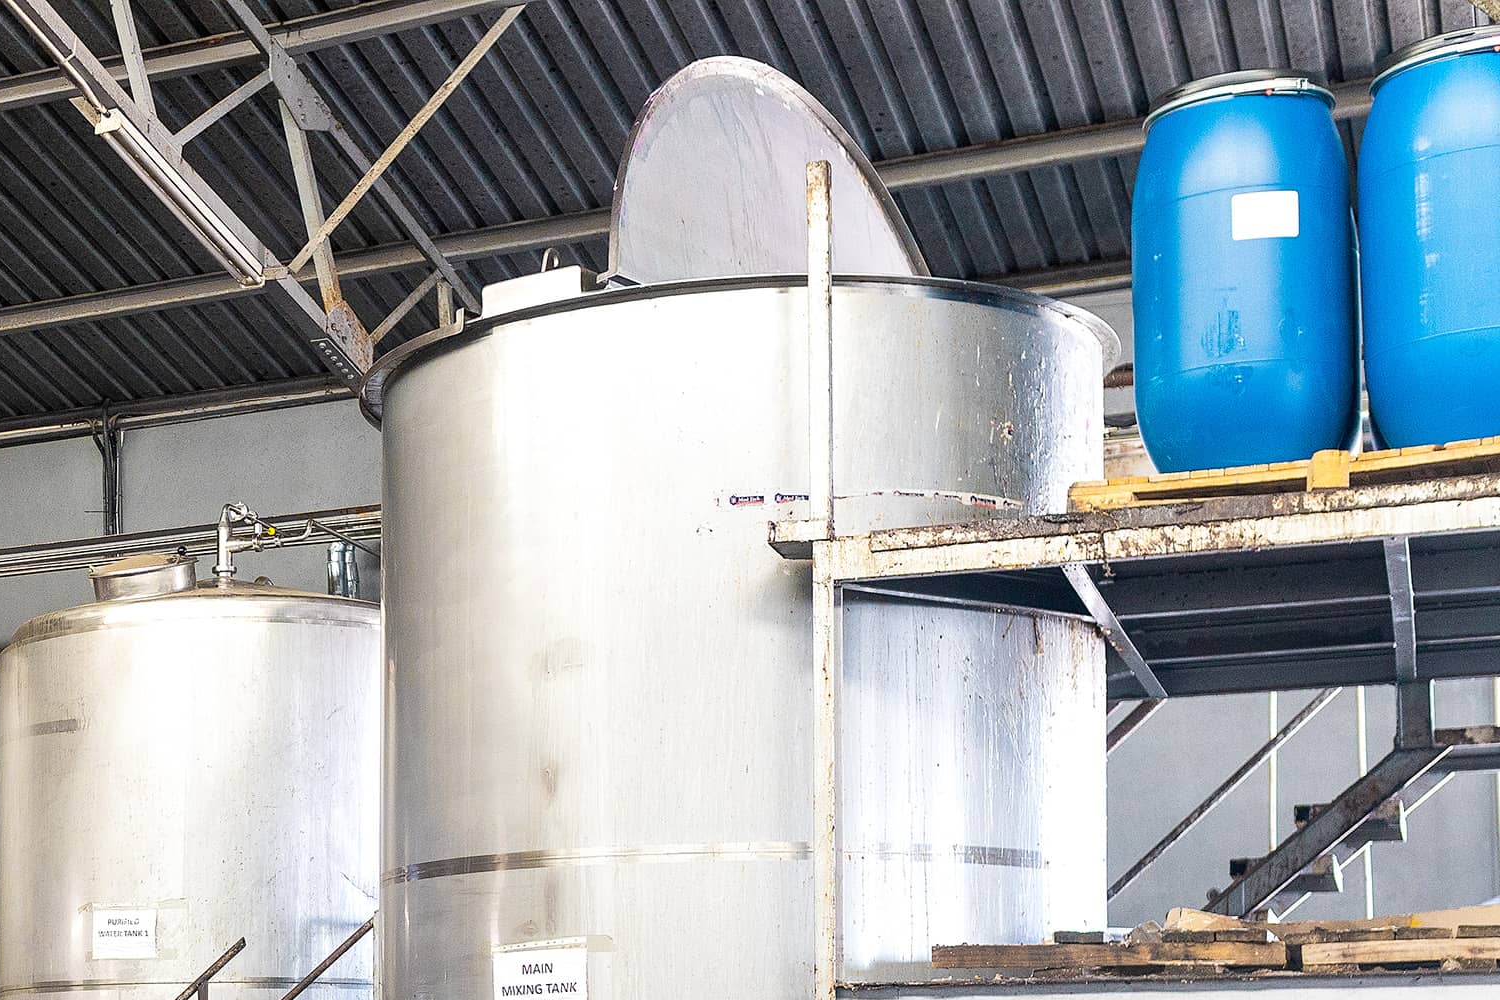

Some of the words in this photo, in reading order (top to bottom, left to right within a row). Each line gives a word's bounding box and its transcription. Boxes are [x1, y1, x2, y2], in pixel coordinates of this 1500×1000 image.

[107, 918, 139, 926] PURIFIED
[521, 962, 554, 976] MAIN
[501, 983, 543, 997] MIXING
[545, 982, 578, 994] TANK
